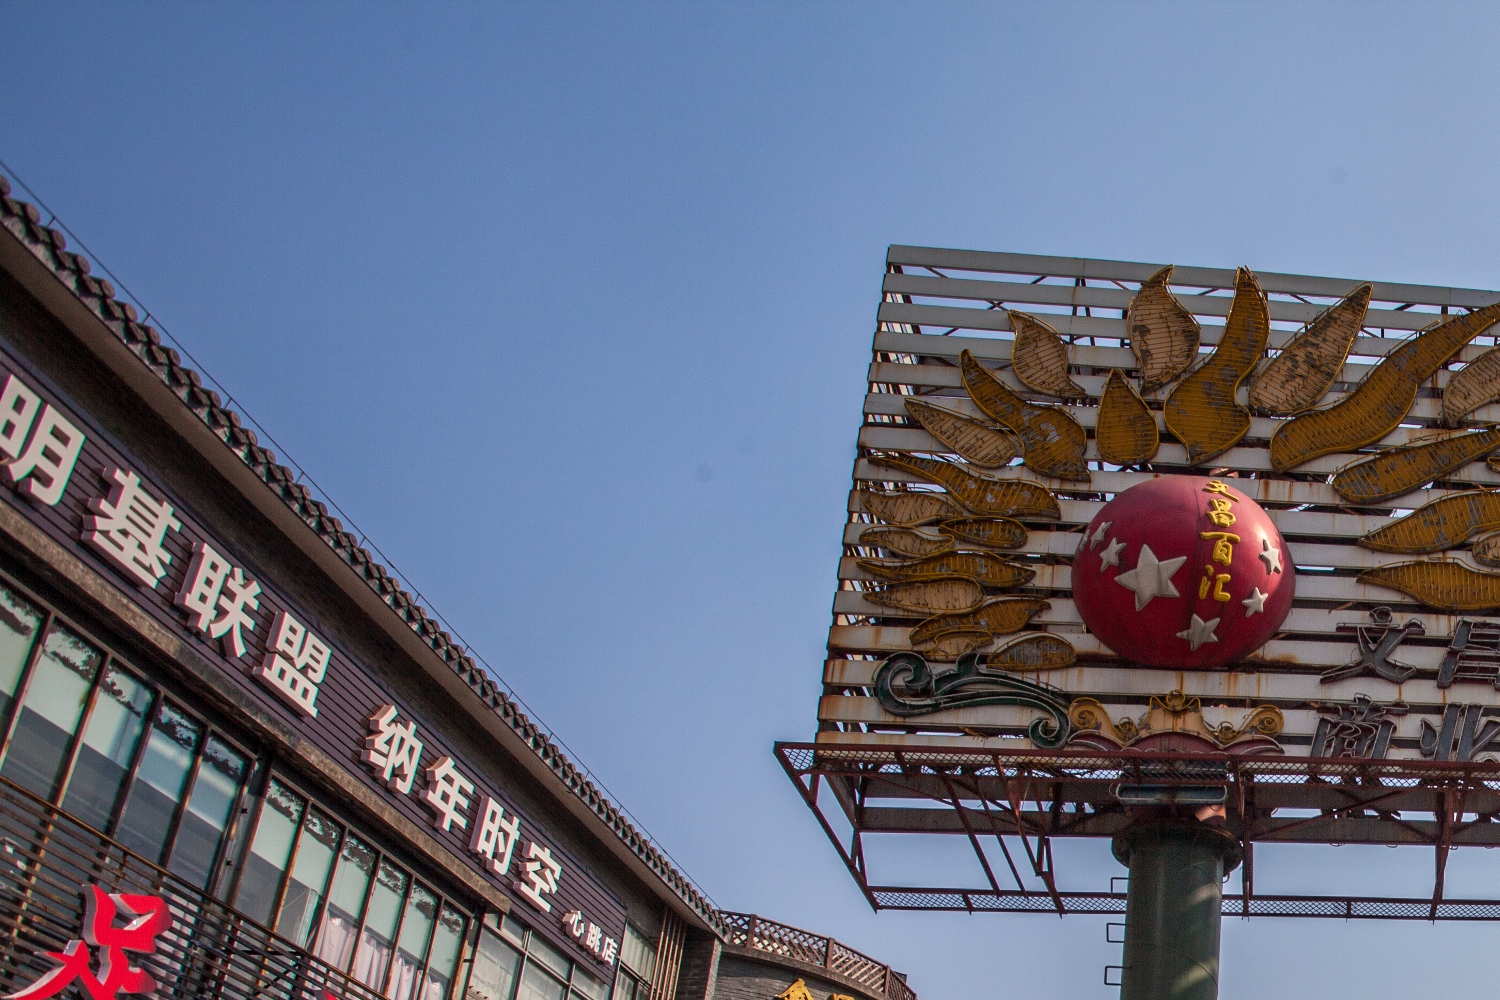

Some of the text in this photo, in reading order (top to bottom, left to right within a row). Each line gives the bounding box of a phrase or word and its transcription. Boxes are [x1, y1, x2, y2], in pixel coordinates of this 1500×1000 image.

[0, 373, 620, 967] 明基联盟 纳年时空 心跳店
